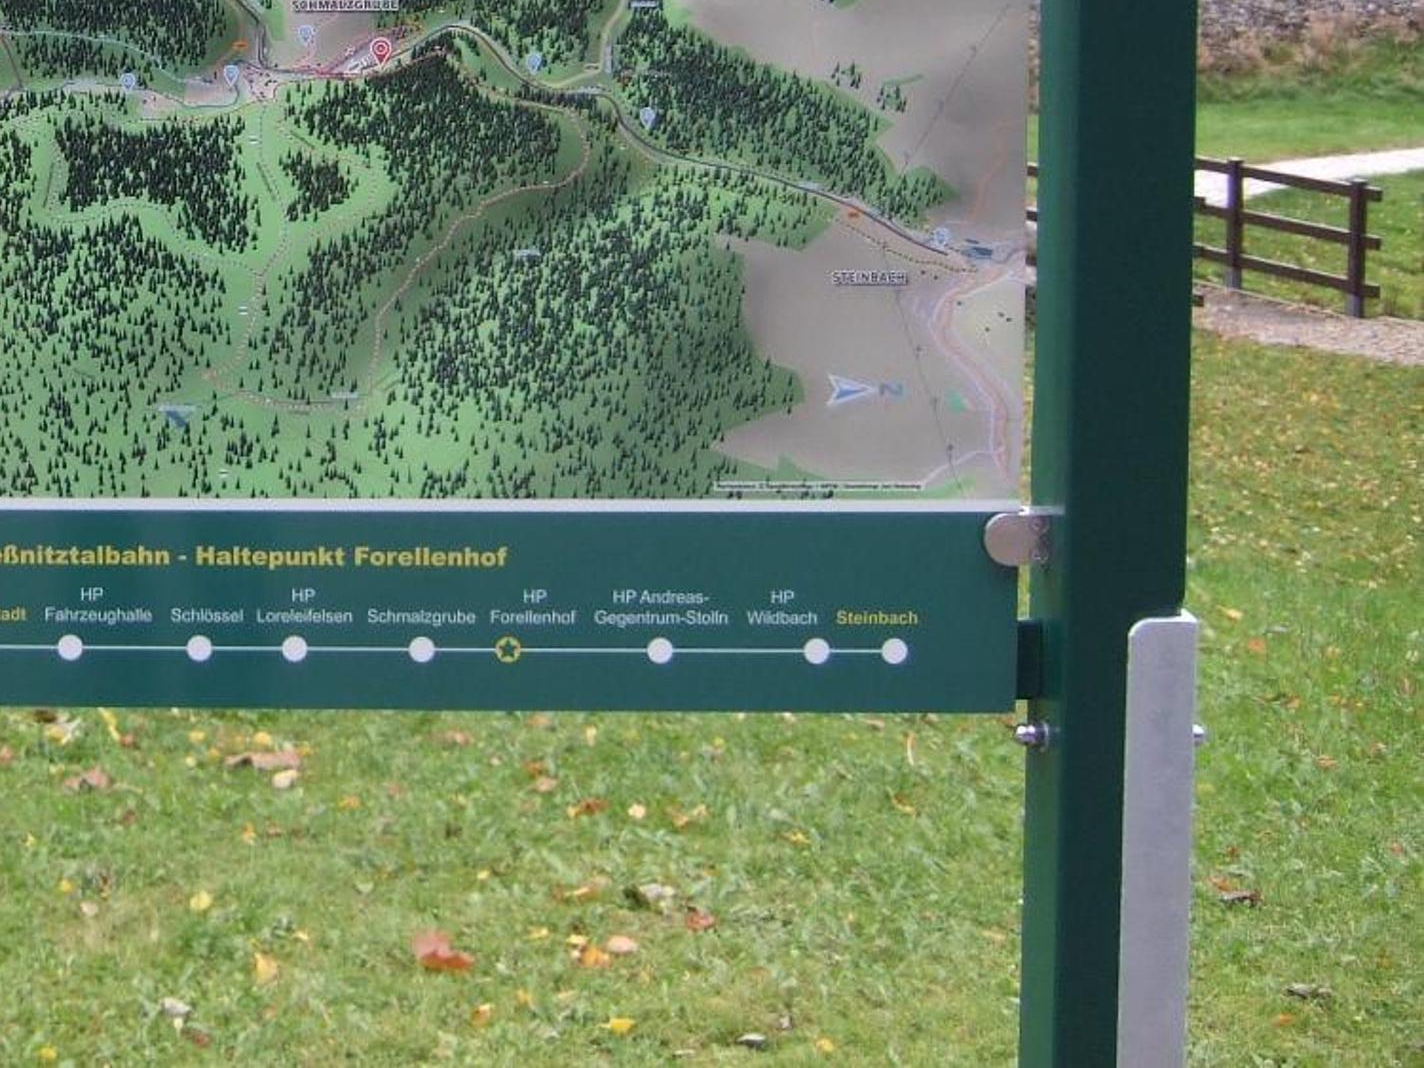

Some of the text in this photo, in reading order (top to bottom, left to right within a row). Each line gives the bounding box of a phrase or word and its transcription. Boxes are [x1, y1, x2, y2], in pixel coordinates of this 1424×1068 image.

[195, 545, 346, 571] Haltepunkt
[353, 545, 508, 568] Forellenhof
[80, 586, 104, 601] HP
[291, 588, 316, 603] HP
[523, 588, 548, 604] HP
[612, 589, 710, 605] HP Andreas-
[770, 589, 795, 604] HP
[44, 606, 153, 626] Fahrzeughalle
[170, 607, 244, 623] Schlössel
[256, 608, 353, 624] Loreleifelsen
[367, 608, 477, 627] Schmalzgrube
[490, 609, 576, 625] Forellenhof
[593, 609, 729, 629] Gegentrum-Stolln
[747, 610, 818, 625] Wildbach
[836, 609, 919, 626] Steinbach
